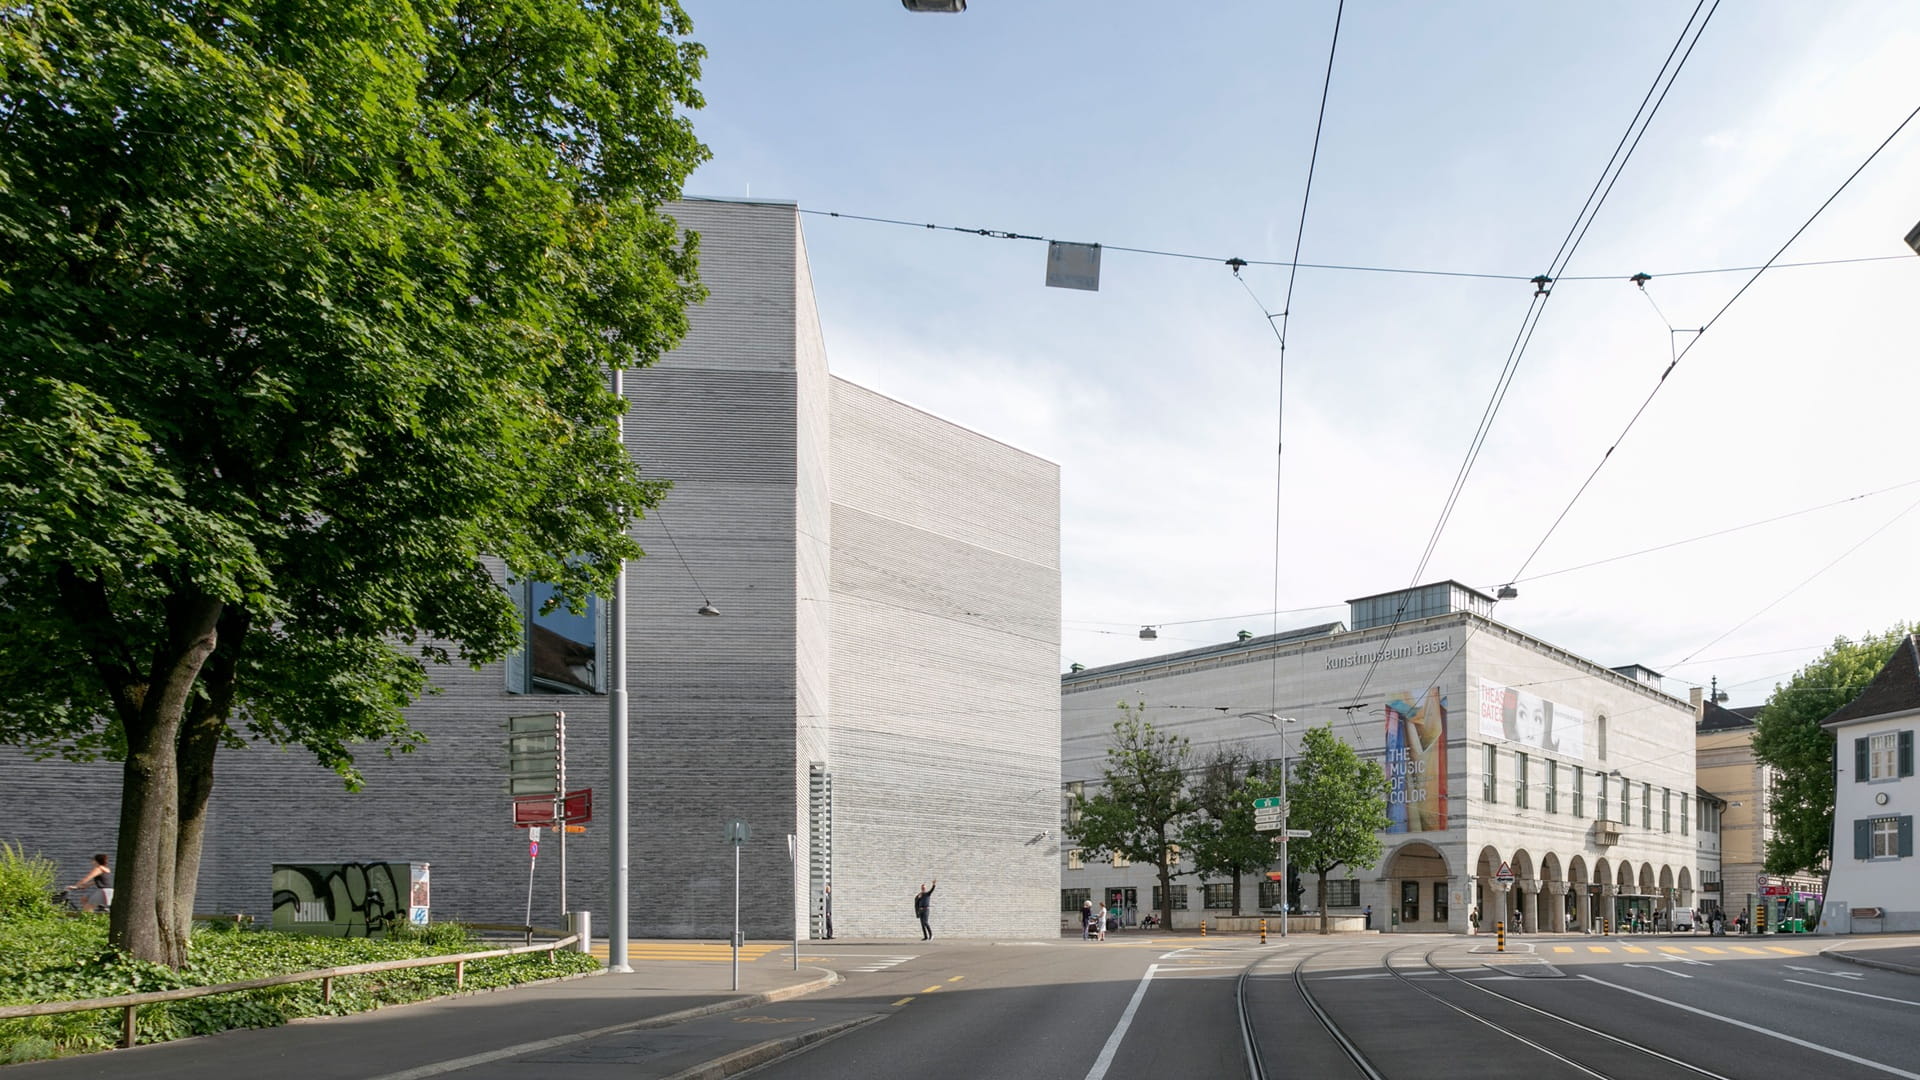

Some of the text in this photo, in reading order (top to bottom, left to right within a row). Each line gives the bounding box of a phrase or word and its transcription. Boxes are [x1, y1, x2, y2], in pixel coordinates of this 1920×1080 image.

[1326, 636, 1453, 670] kunstmuseum basel
[1389, 747, 1411, 761] THE
[1390, 760, 1425, 776] MUSIC
[1390, 776, 1405, 790] OF
[1390, 788, 1426, 804] COLOR
